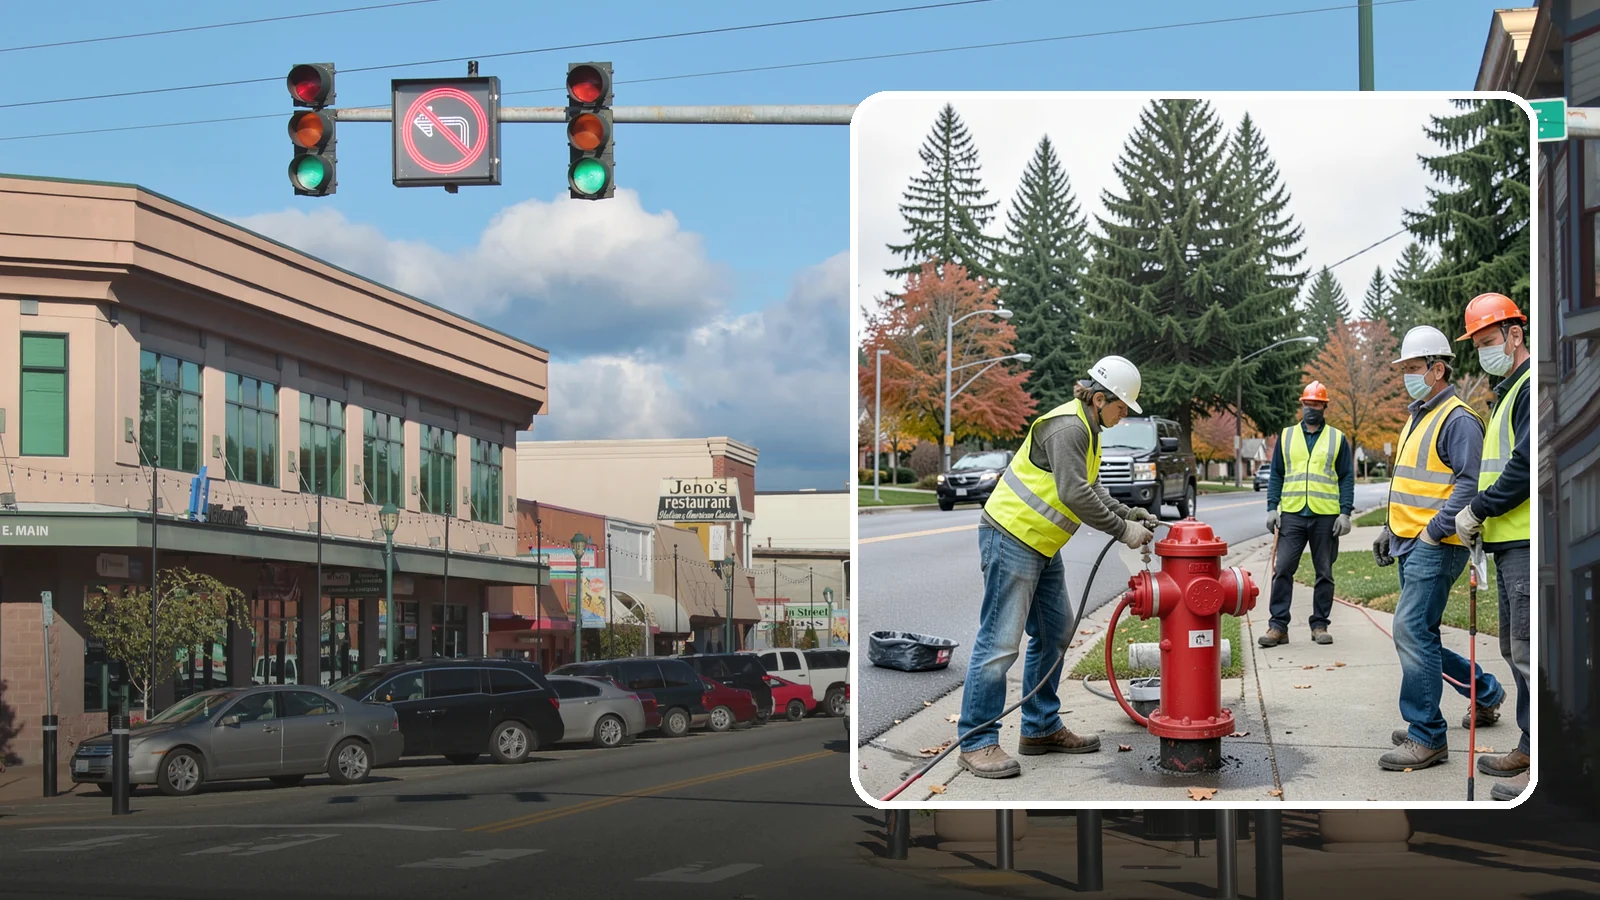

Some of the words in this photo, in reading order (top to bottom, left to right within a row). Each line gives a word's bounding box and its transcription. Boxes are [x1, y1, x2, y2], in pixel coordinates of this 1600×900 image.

[670, 480, 728, 495] Jeno's
[665, 496, 731, 509] restaurant
[658, 509, 681, 519] Italian
[686, 509, 714, 519] American
[715, 509, 738, 519] Cuisine
[2, 525, 13, 536] E.
[15, 525, 49, 536] MAIN
[797, 607, 828, 617] Street
